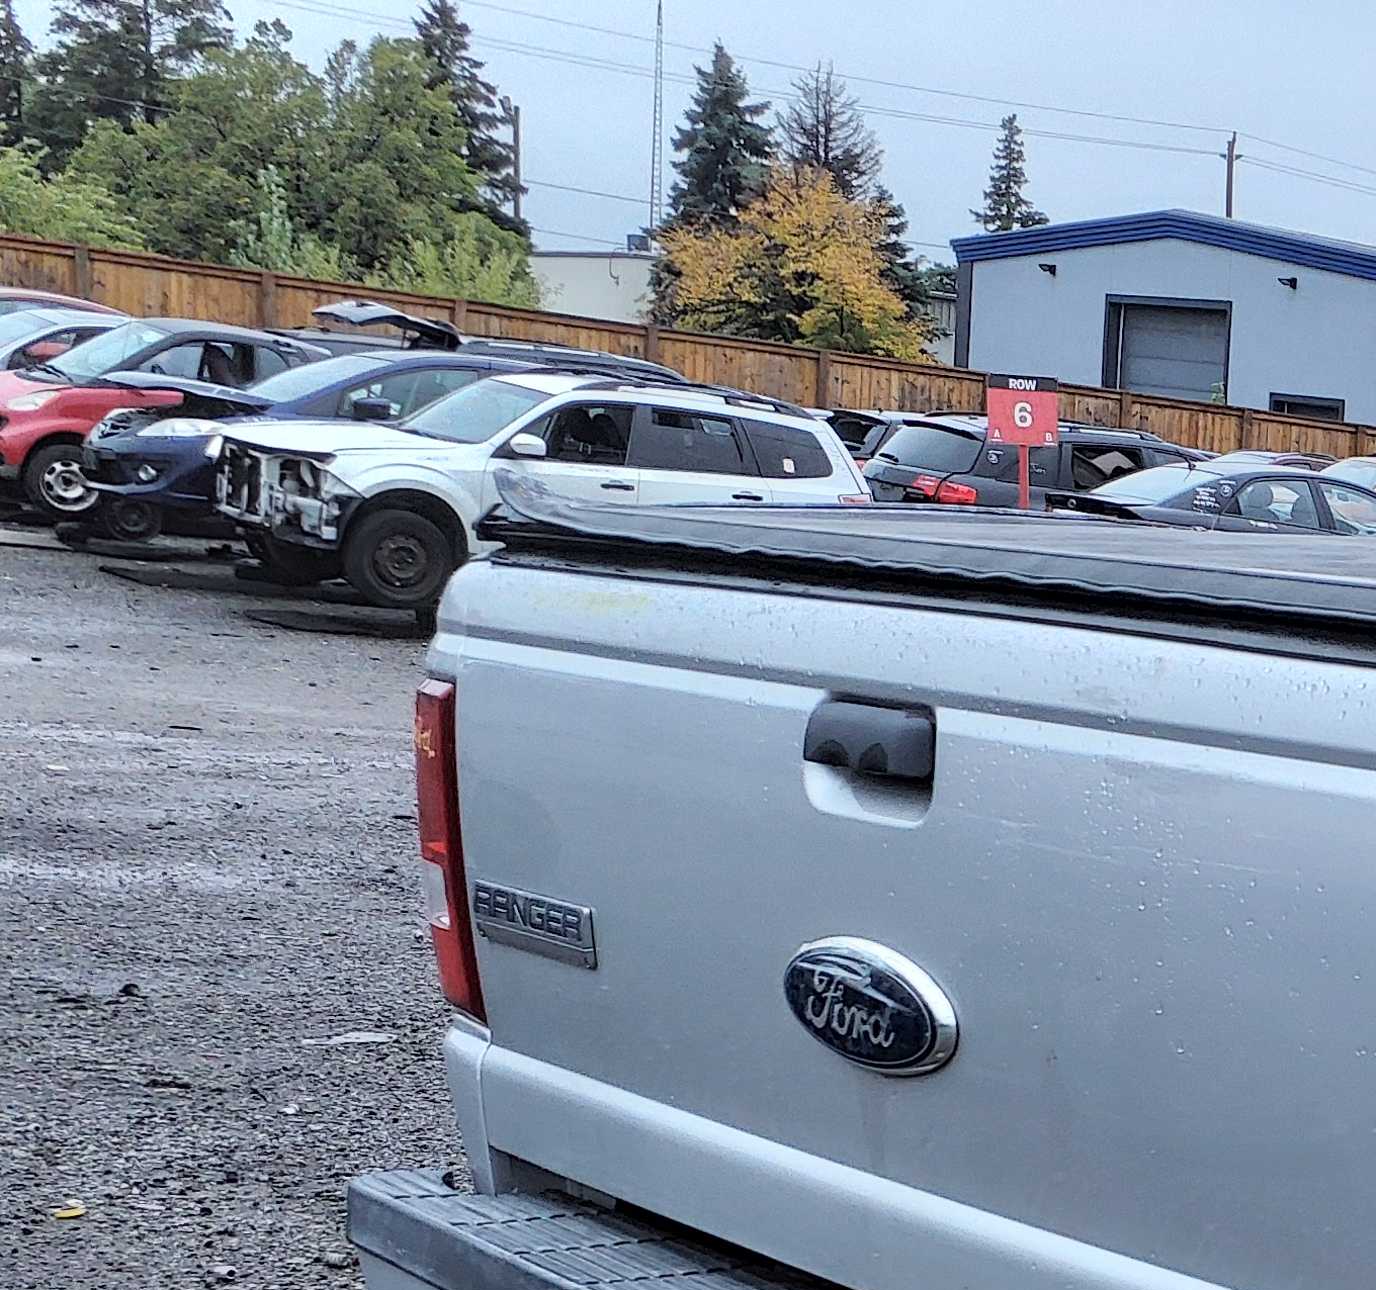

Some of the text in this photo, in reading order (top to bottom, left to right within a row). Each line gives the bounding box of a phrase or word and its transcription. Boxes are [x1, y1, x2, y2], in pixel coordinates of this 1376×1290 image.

[1008, 378, 1037, 391] ROW
[1013, 401, 1033, 428] 6
[993, 429, 1053, 442] A B
[475, 883, 583, 941] RANGER
[798, 956, 908, 1048] Ford
